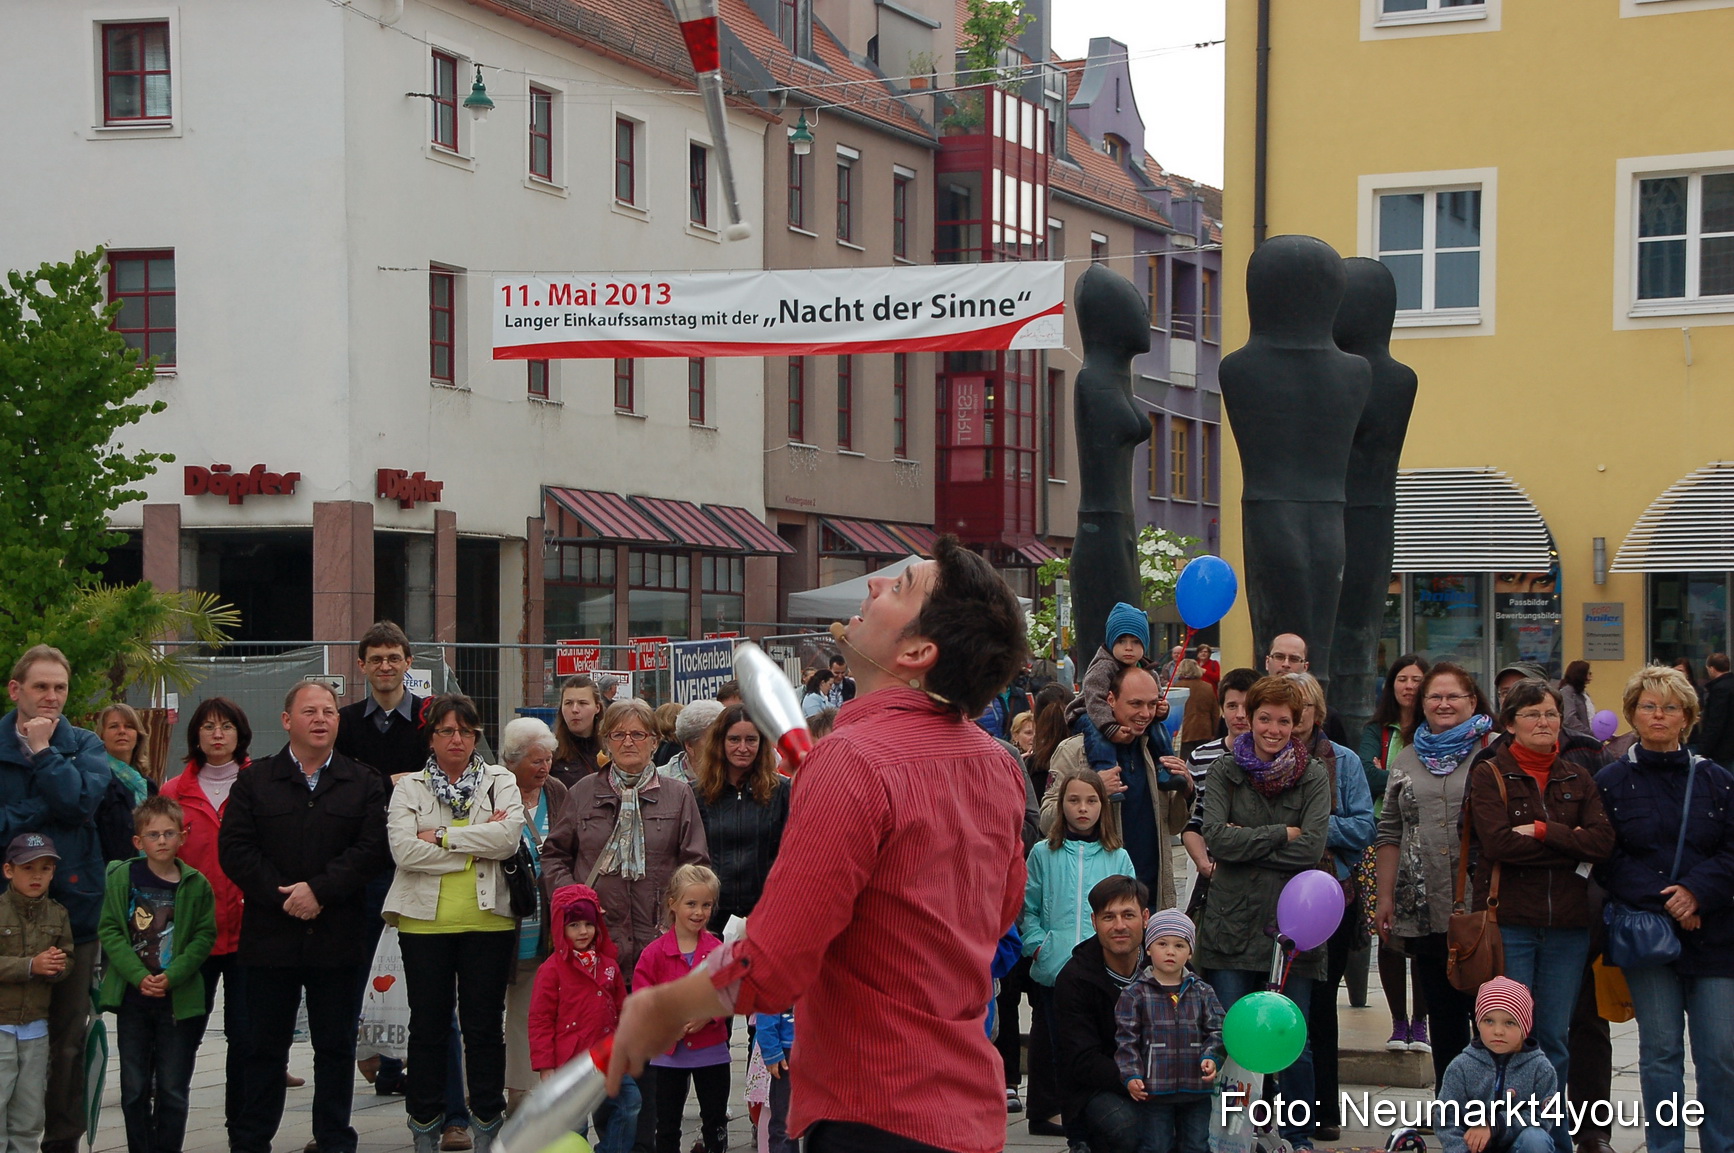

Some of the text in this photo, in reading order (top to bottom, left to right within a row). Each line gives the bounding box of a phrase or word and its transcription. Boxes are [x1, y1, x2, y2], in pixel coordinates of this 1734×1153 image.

[501, 282, 672, 307] 11. Mai 2013
[504, 290, 1032, 331] Langer Einkaufssamstag mit der „Nacht der Sinne“
[184, 464, 301, 505] Döpfer
[377, 468, 443, 509] Döpfer
[1509, 598, 1549, 606] Passbilder
[675, 645, 732, 673] Trockenbau
[403, 679, 423, 688] FERT
